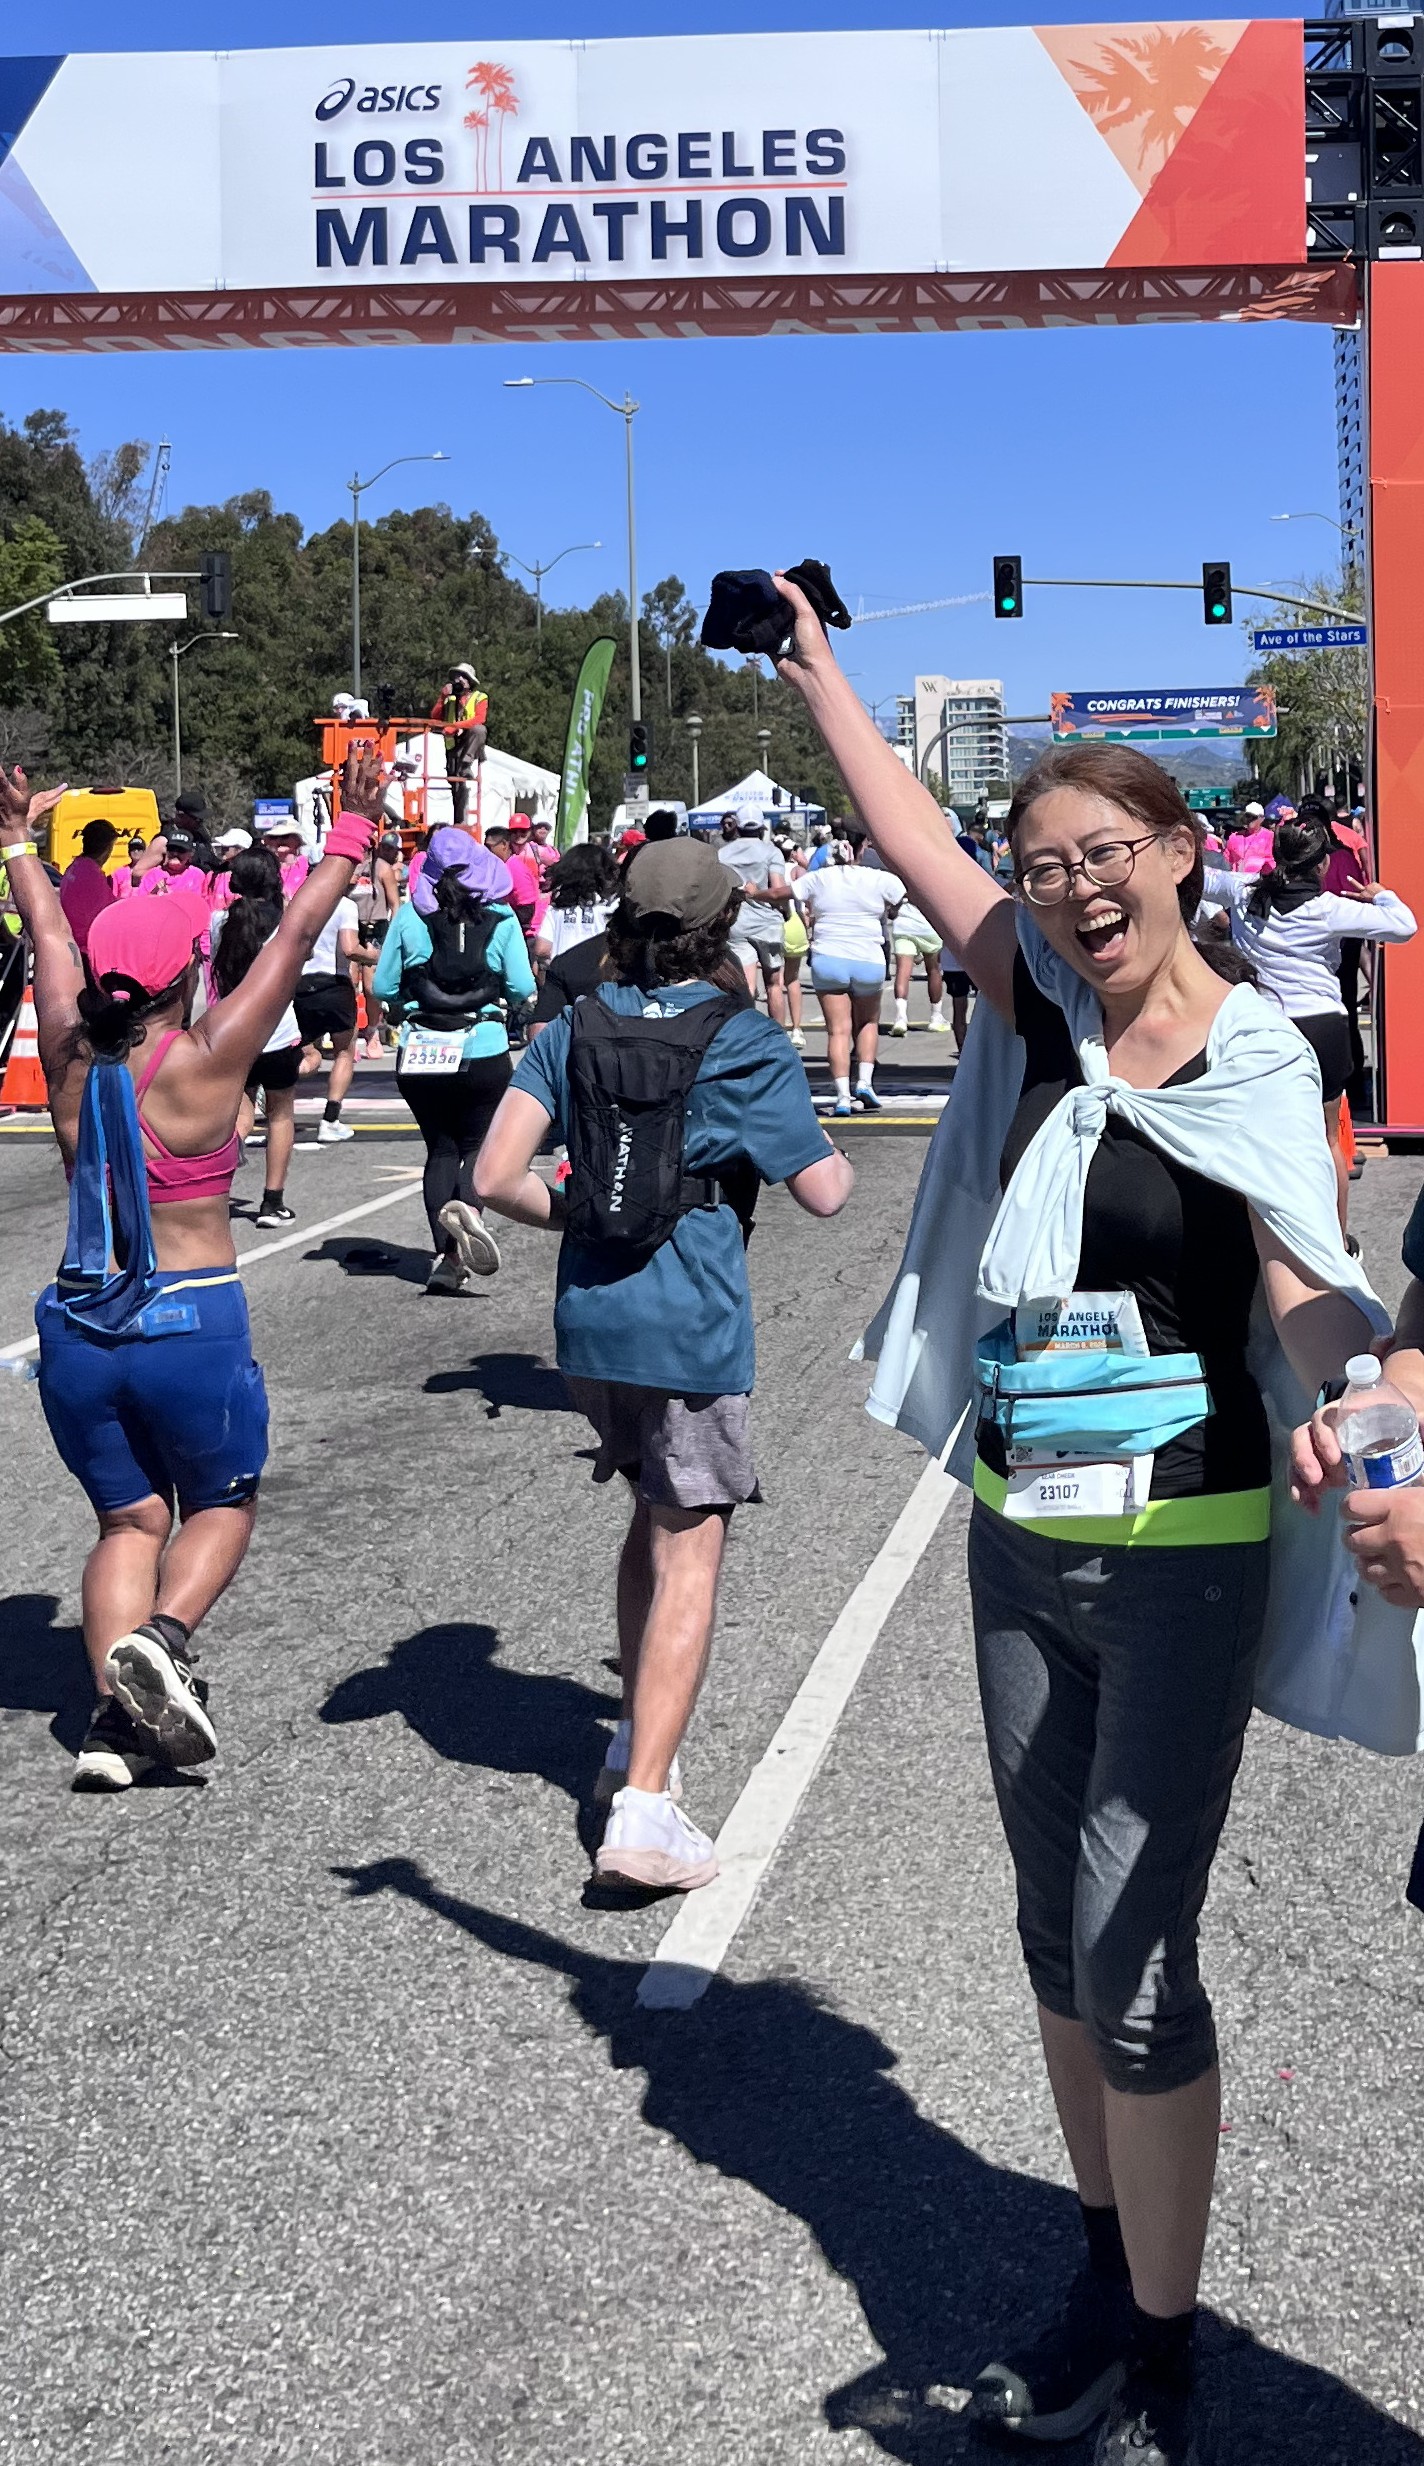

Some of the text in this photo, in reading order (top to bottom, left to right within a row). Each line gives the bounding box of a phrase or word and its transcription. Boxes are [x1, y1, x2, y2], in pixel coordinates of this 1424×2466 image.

[357, 84, 442, 113] asics
[314, 128, 847, 188] LOS ANGELES
[316, 195, 847, 268] MARATHON
[1260, 629, 1362, 646] Ave of the Stars
[1087, 695, 1241, 712] CONGRATS FINISHERS!
[1039, 1310, 1115, 1323] LOS ANGELE
[1039, 1483, 1080, 1500] 23107
